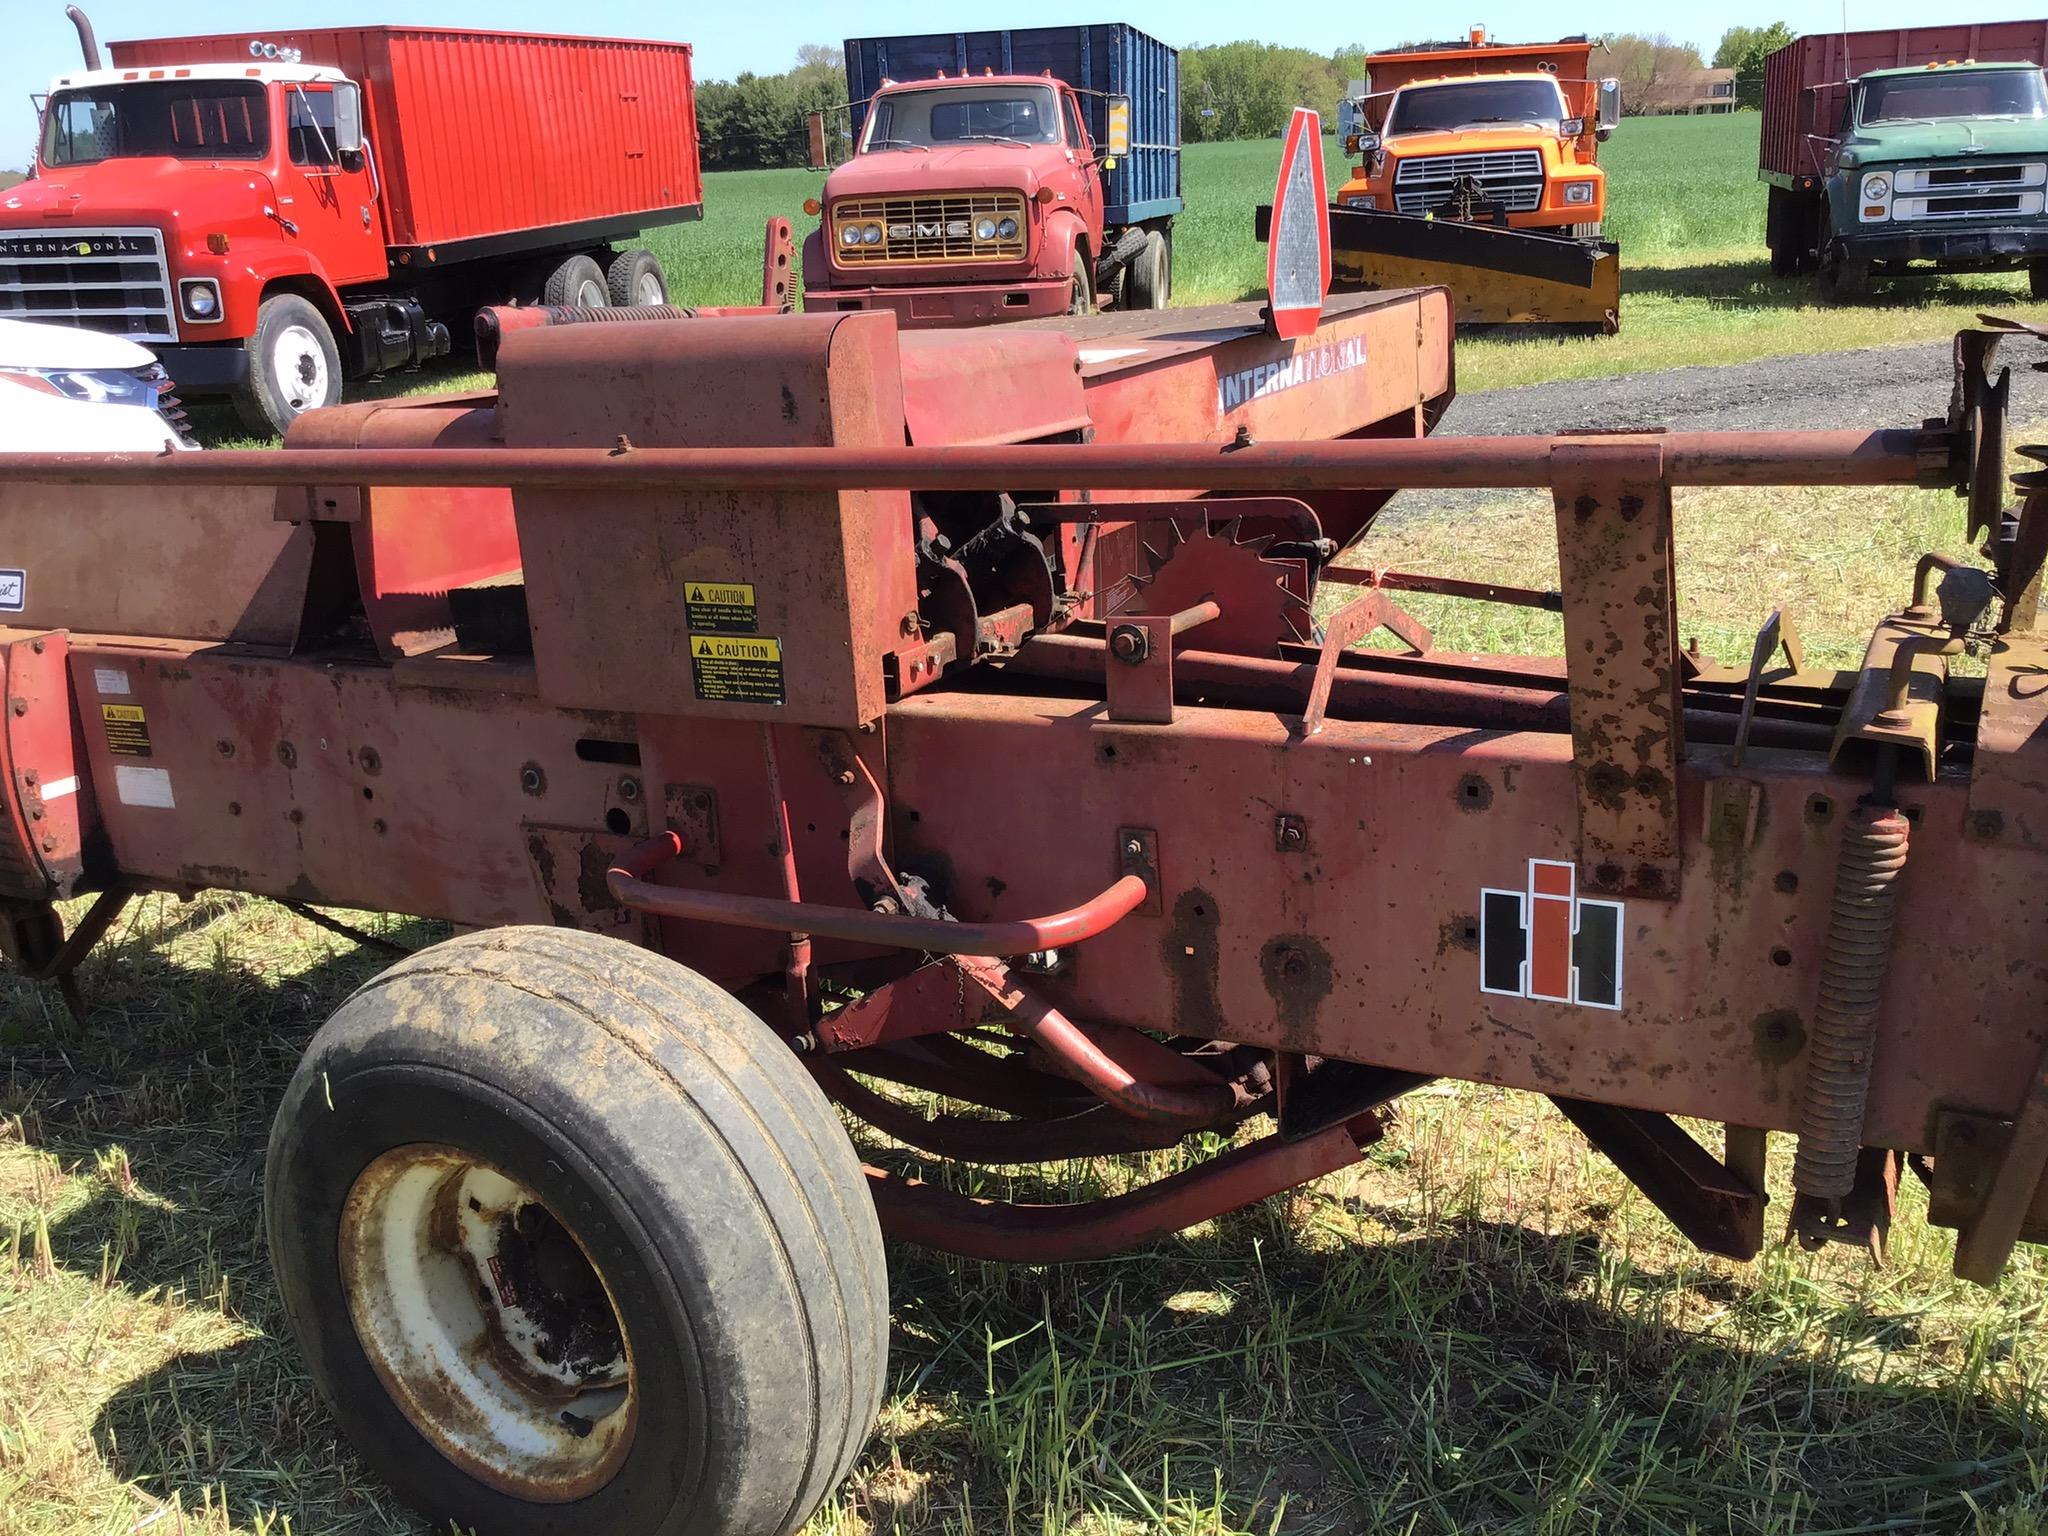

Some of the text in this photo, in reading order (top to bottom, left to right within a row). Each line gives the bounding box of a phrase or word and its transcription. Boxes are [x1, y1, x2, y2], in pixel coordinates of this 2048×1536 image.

[889, 222, 969, 238] GMC
[0, 242, 138, 253] NTERNATONAL
[1218, 336, 1367, 413] INTERNATIONAL
[708, 589, 746, 604] CAUTION
[717, 643, 768, 658] CAUTION
